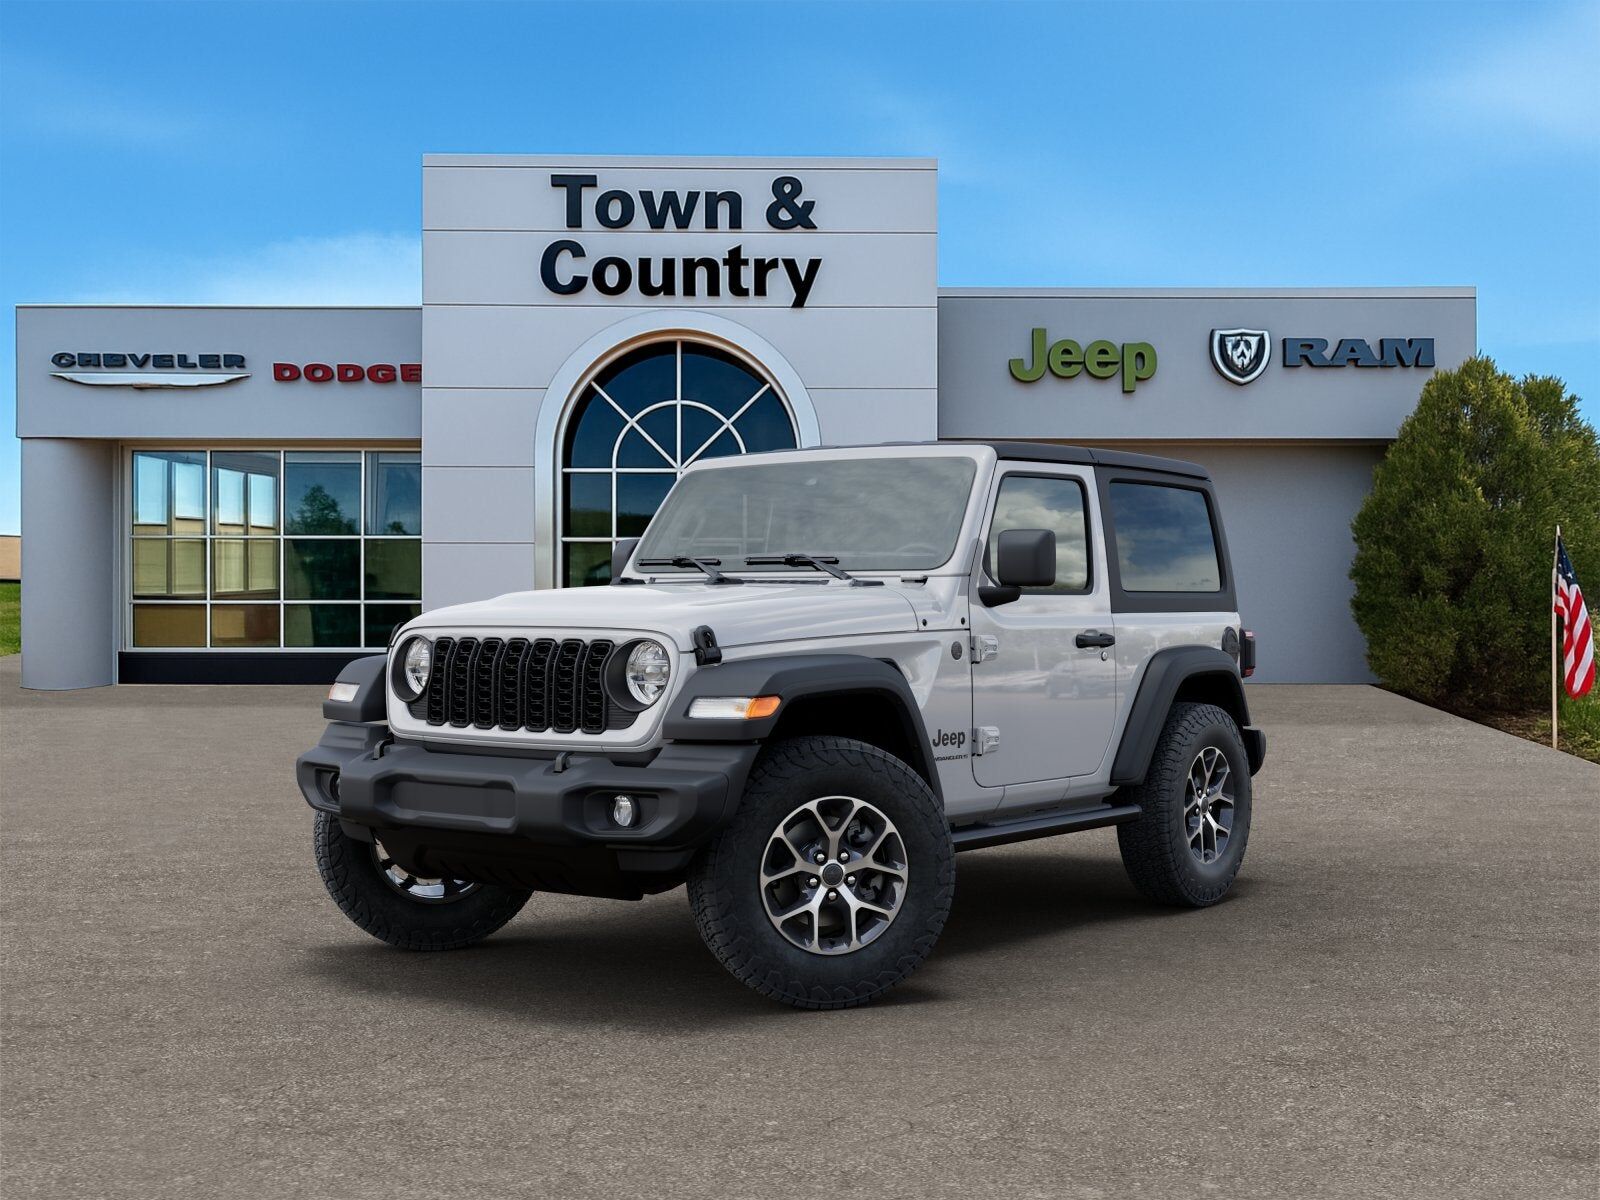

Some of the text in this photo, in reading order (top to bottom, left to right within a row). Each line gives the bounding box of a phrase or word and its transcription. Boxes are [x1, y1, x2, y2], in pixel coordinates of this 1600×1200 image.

[551, 174, 818, 230] Town &
[540, 239, 822, 308] Country
[273, 362, 422, 382] DODGE
[1009, 328, 1158, 393] Jeep
[1282, 337, 1436, 367] RAM
[932, 729, 966, 748] Jeep
